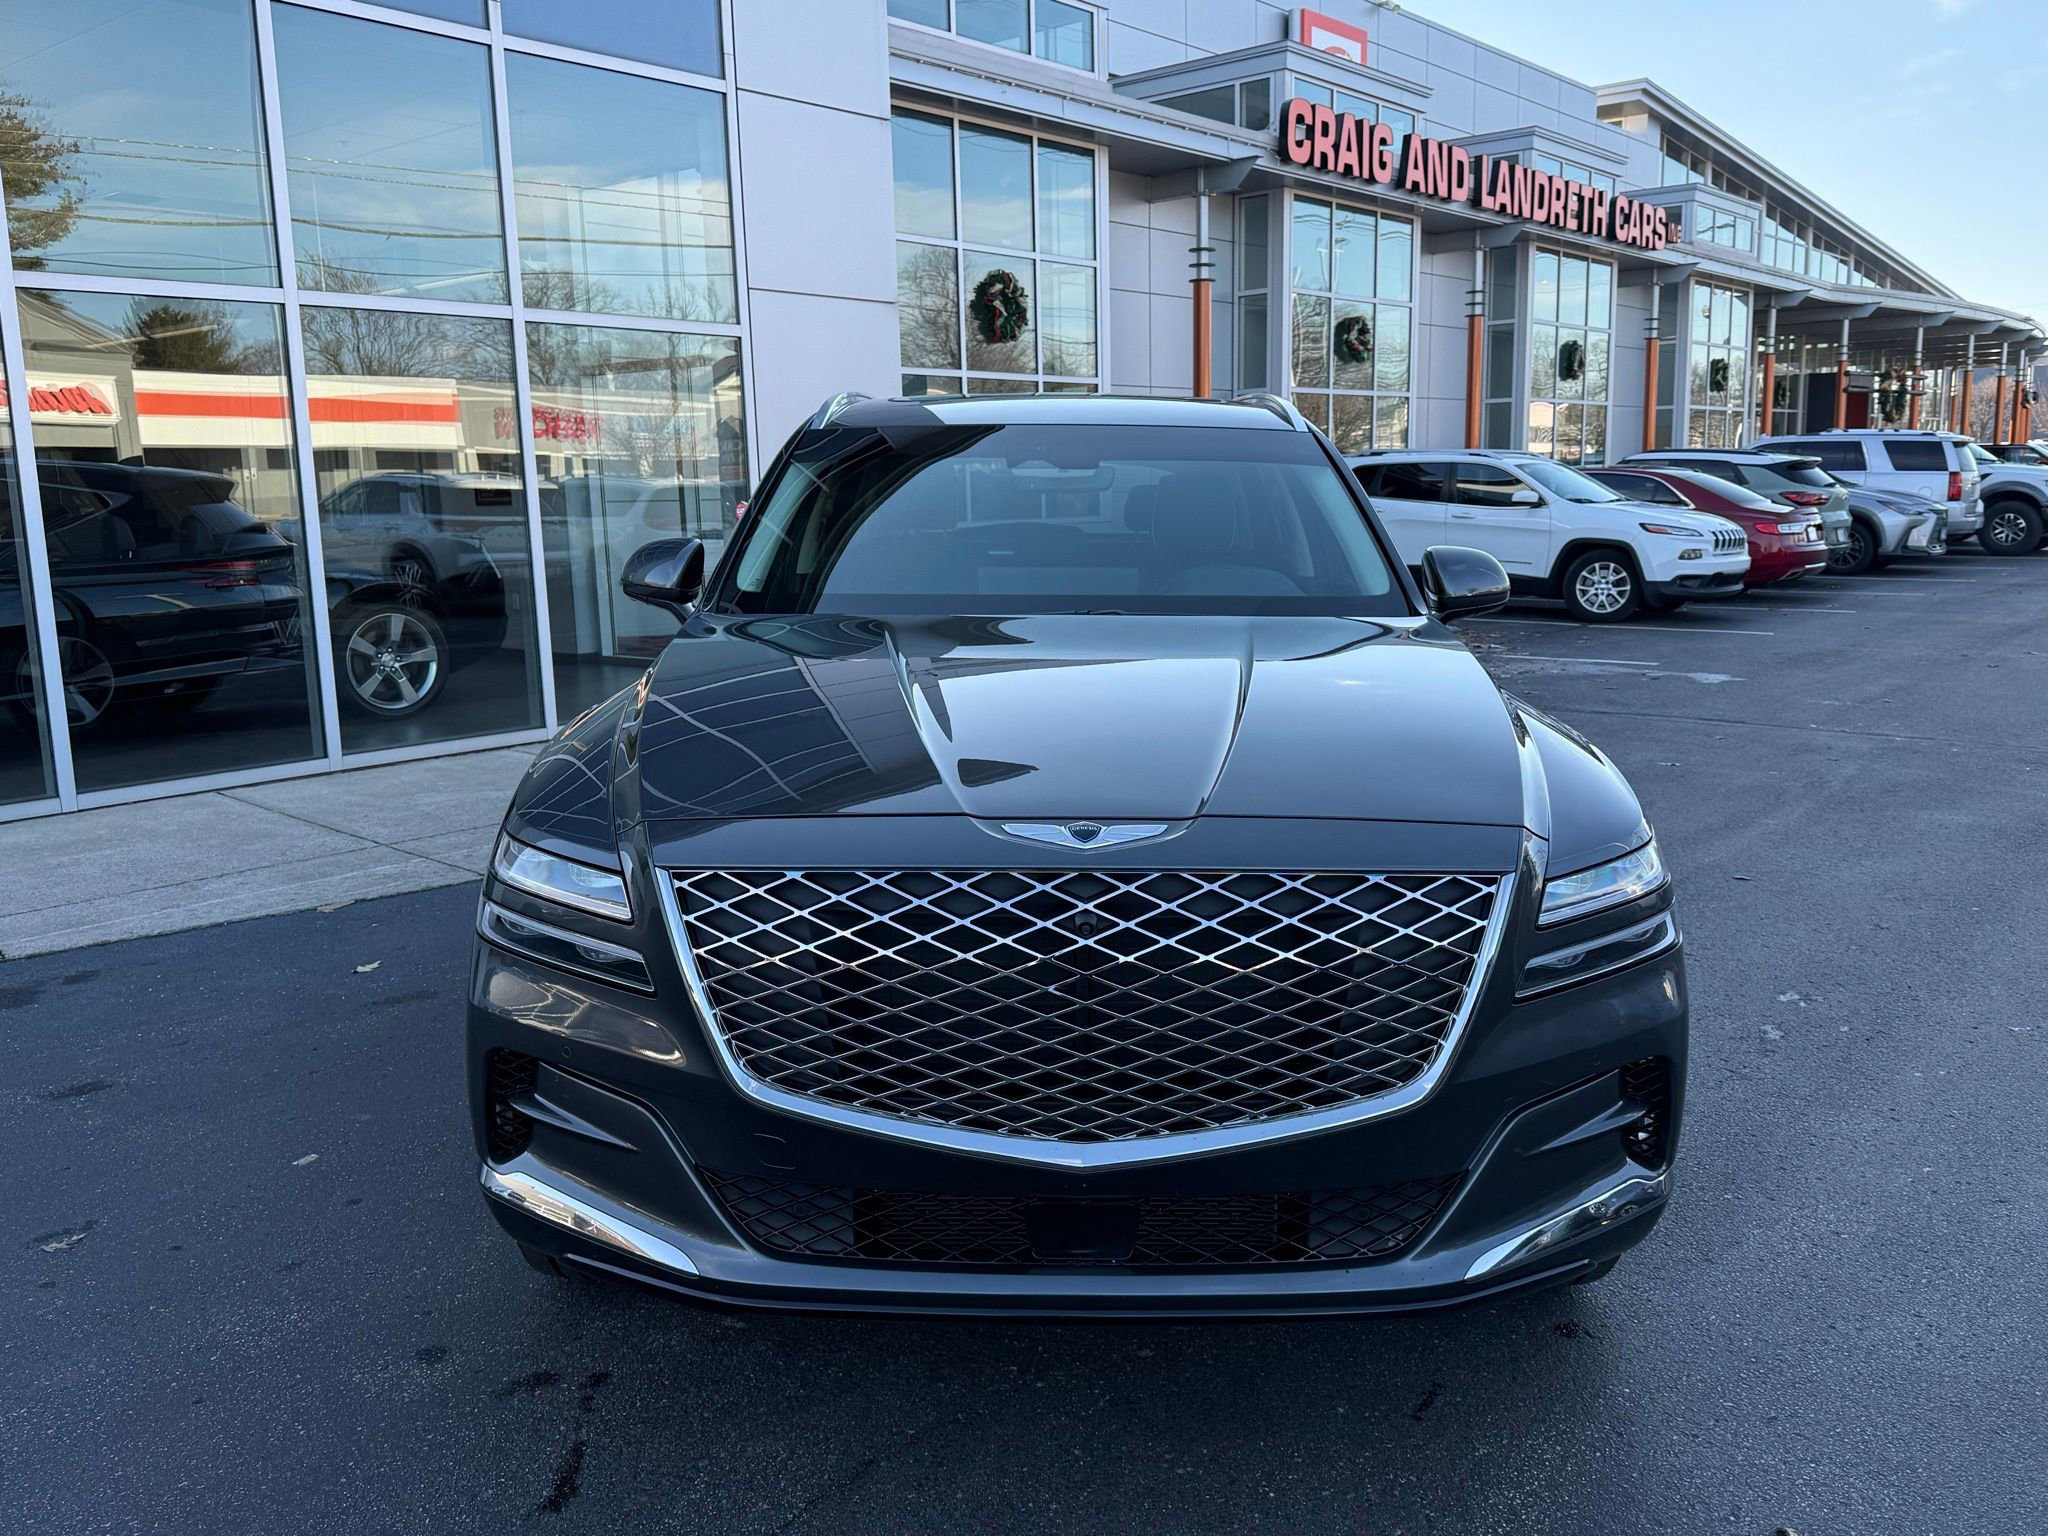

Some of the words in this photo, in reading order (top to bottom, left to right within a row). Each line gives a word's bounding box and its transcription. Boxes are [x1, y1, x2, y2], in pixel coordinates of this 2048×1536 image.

[1286, 97, 1393, 184] CRAIG
[1405, 133, 1470, 202] AND
[1481, 154, 1608, 237] LANDRETH
[1615, 195, 1667, 250] CARS
